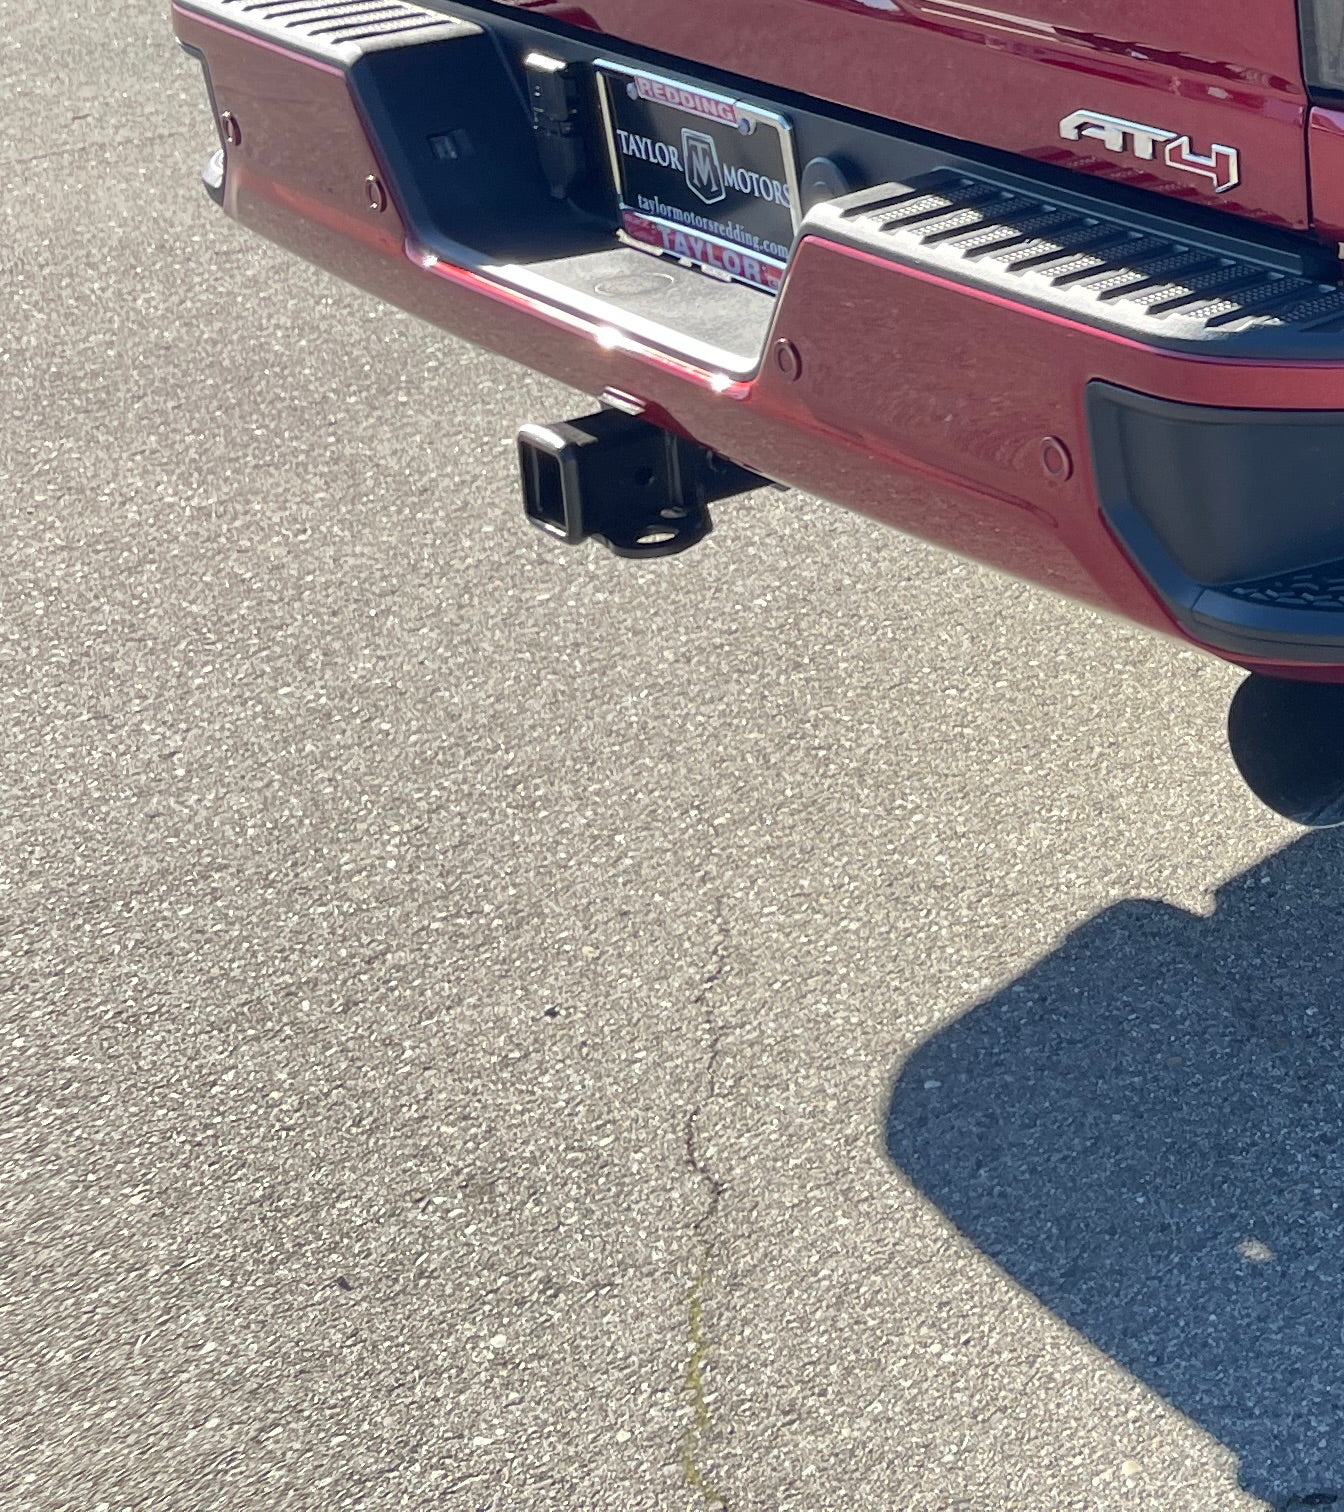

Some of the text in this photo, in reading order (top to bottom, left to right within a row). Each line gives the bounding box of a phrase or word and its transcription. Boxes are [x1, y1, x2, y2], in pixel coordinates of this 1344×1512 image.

[637, 76, 734, 121] REDDING
[617, 128, 684, 172] TAYLOR
[723, 162, 791, 208] MOTORS
[1059, 109, 1239, 193] AT4
[637, 193, 789, 257] taylormotorsredding.com
[655, 224, 762, 284] TAYLOR
